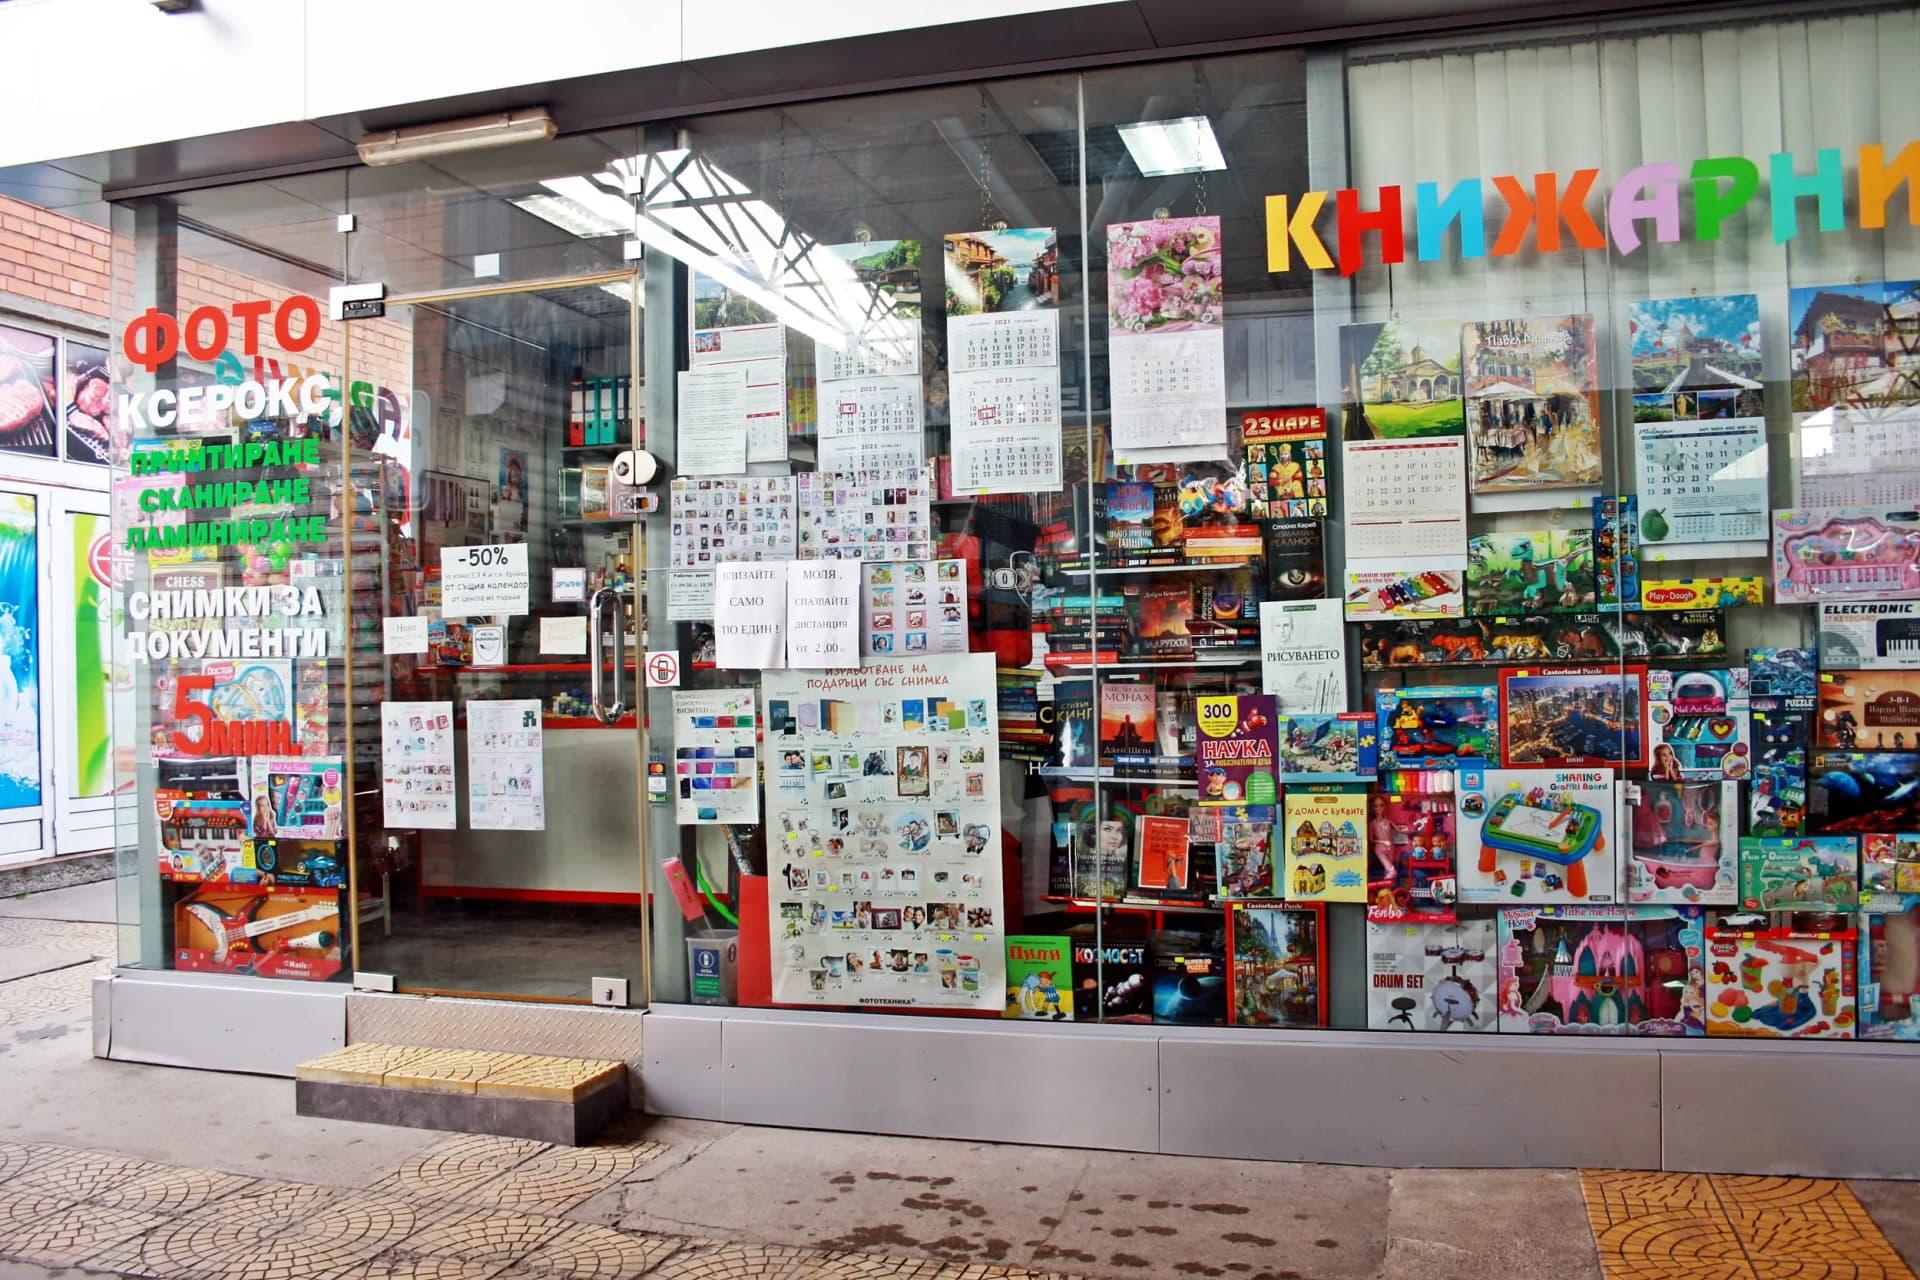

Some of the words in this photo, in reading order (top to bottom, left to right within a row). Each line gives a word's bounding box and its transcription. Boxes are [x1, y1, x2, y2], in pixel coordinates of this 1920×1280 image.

[122, 294, 321, 373] ФОТО
[1485, 334, 1520, 348] Павел
[118, 374, 334, 430] КСЕРОКС
[1245, 417, 1271, 436] 23
[1272, 414, 1321, 433] ЦАРЕ
[129, 438, 321, 476] ПРИНТИРАНЕ
[139, 478, 311, 513] СКАНИРАНЕ
[125, 516, 327, 551] ЛАМИНИРАНЕ
[458, 547, 508, 566] -50%
[165, 575, 206, 588] CHESS
[129, 588, 271, 620] СНИМКИ
[282, 586, 326, 616] ЗА
[729, 596, 765, 607] САМО
[1824, 604, 1913, 614] ELECTRONIC
[722, 625, 738, 635] ПО
[741, 624, 773, 636] ЕДИН
[127, 627, 327, 660] ДОКУМЕНТИ
[1267, 649, 1340, 663] РИСУВАНЕТО
[825, 664, 907, 676] ИЗРАБОТВАНЕ
[912, 664, 928, 674] НА
[807, 677, 867, 691] ПОДАРЪЦИ
[874, 676, 894, 687] СЪС
[902, 675, 949, 687] СНИМКА
[1104, 692, 1152, 702] МОНАХ
[172, 674, 215, 756] 5
[210, 720, 303, 757] МИН.
[1056, 708, 1093, 722] КИНГ
[1203, 704, 1232, 719] 300
[1674, 705, 1688, 713] Nail
[1690, 705, 1702, 713] Art
[1704, 705, 1725, 713] Studio
[1202, 739, 1271, 760] НАУКА
[1556, 773, 1602, 782] SHARING
[1550, 783, 1580, 791] Graffiti
[1582, 782, 1608, 790] Board
[1295, 807, 1320, 816] ДОМА
[1322, 808, 1329, 816] С
[1331, 807, 1365, 816] БУКВИТЕ
[1564, 906, 1588, 917] Take
[1010, 945, 1061, 961] Пипи
[1373, 974, 1404, 989] DRUM
[1406, 974, 1424, 988] SET
